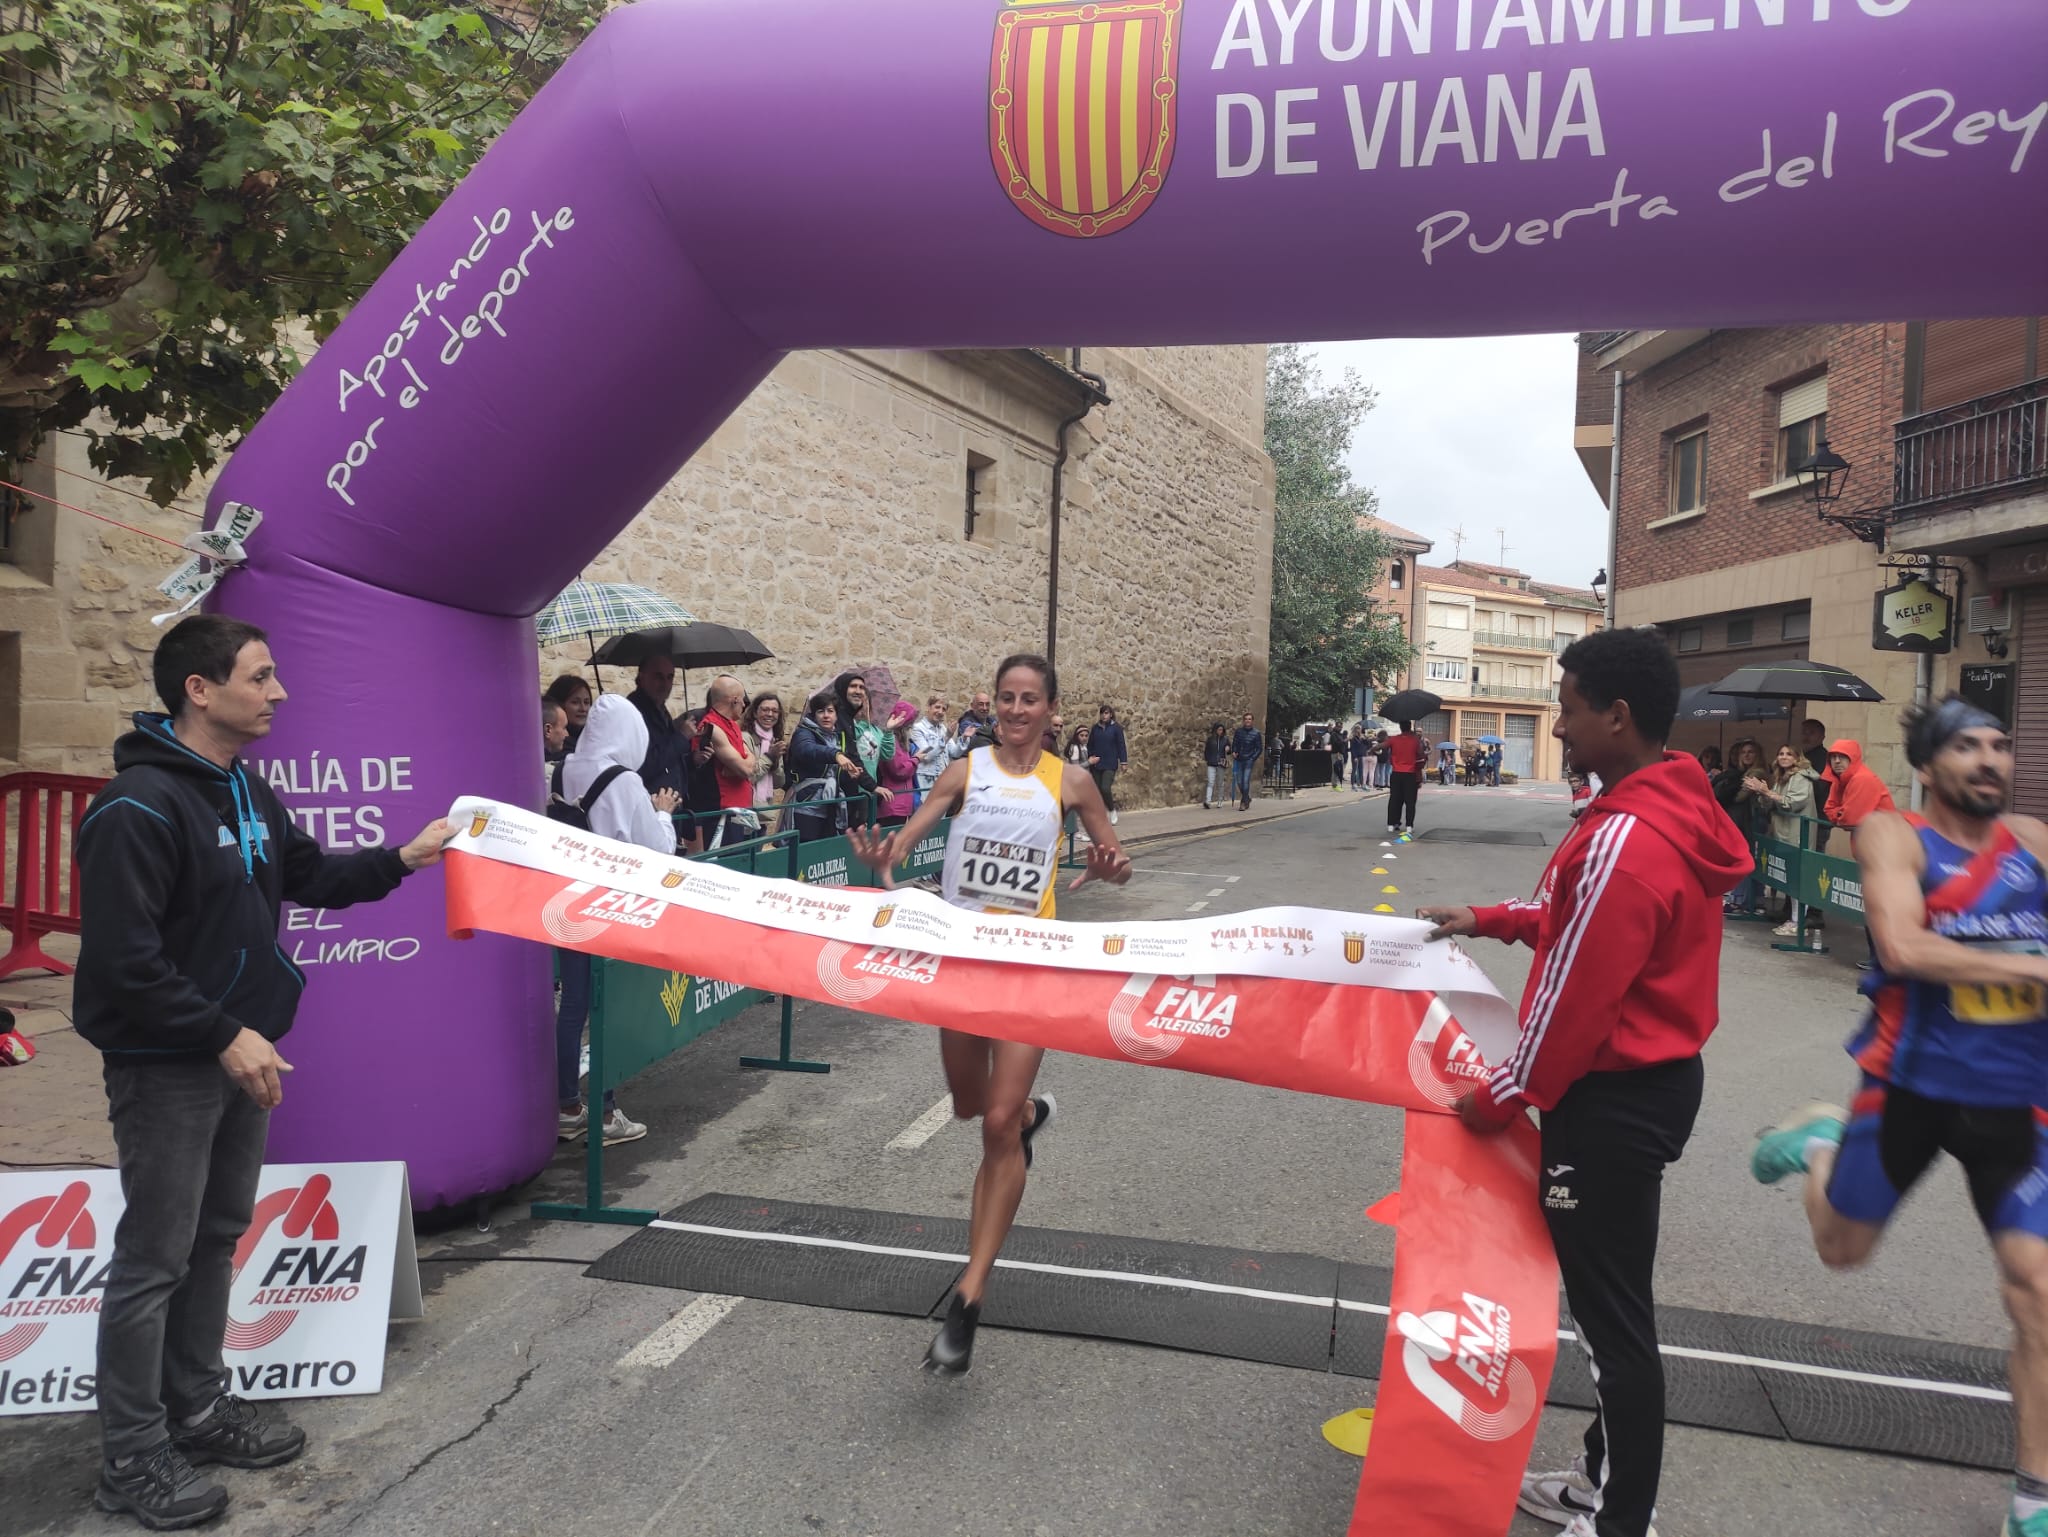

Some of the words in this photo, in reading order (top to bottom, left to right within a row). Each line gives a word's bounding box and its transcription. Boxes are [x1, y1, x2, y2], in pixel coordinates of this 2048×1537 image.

[1216, 87, 1319, 178] DE
[1343, 67, 1606, 170] VIANA
[1417, 168, 1679, 265] Puerta
[1718, 112, 1837, 202] del
[1883, 89, 2048, 172] Rey
[337, 207, 512, 412] Apostando
[326, 417, 385, 506] por
[399, 358, 429, 409] el
[439, 206, 576, 365] deporte
[1895, 602, 1933, 620] KELER
[361, 756, 413, 792] DE
[557, 835, 588, 852] VIANA
[590, 846, 644, 869] TREKKING
[808, 862, 824, 880] CAJA
[825, 857, 847, 875] RURAL
[963, 858, 1041, 894] 1042
[590, 889, 669, 921] FNA
[761, 889, 793, 904] VIANA
[795, 897, 852, 914] TREKKING
[287, 907, 343, 931] EL
[578, 907, 657, 929] ATLETISMO
[975, 925, 1009, 938] VIANA
[1014, 927, 1074, 943] TREKKING
[1211, 928, 1247, 940] VIANA
[1251, 925, 1314, 941] TREKKING
[1370, 939, 1424, 952] AYUNTAMIENTO
[292, 938, 420, 966] LIMPIO
[863, 945, 943, 976] FNA
[1380, 949, 1401, 957] VIANA
[853, 960, 935, 985] ATLETISMO
[695, 985, 711, 1014] DE
[1153, 986, 1238, 1026] FNA
[1145, 1015, 1231, 1039] ATLETISMO
[1548, 1185, 1570, 1199] PA
[259, 1245, 368, 1287] FNA
[248, 1286, 360, 1306] ATLETISMO
[1456, 1291, 1497, 1387] FNA
[1485, 1304, 1511, 1398] ATLETISMO
